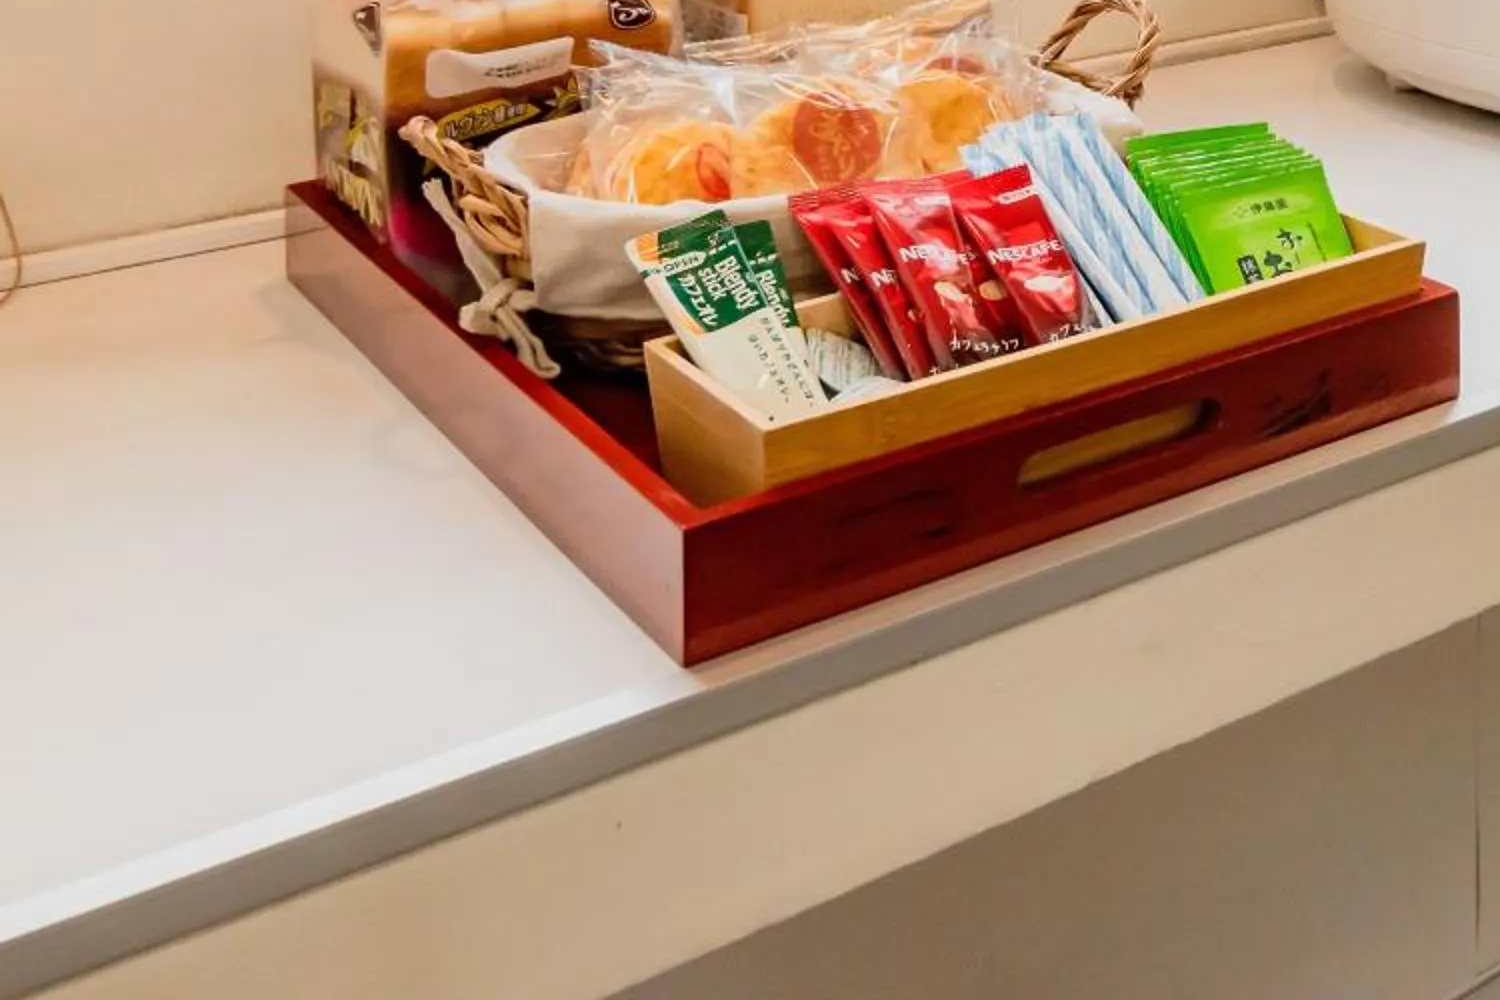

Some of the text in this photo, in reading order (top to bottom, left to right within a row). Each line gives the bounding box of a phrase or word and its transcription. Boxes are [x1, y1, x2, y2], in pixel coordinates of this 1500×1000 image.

[678, 272, 720, 327] カフェオレ
[698, 266, 727, 301] stick
[714, 255, 760, 310] Blendy
